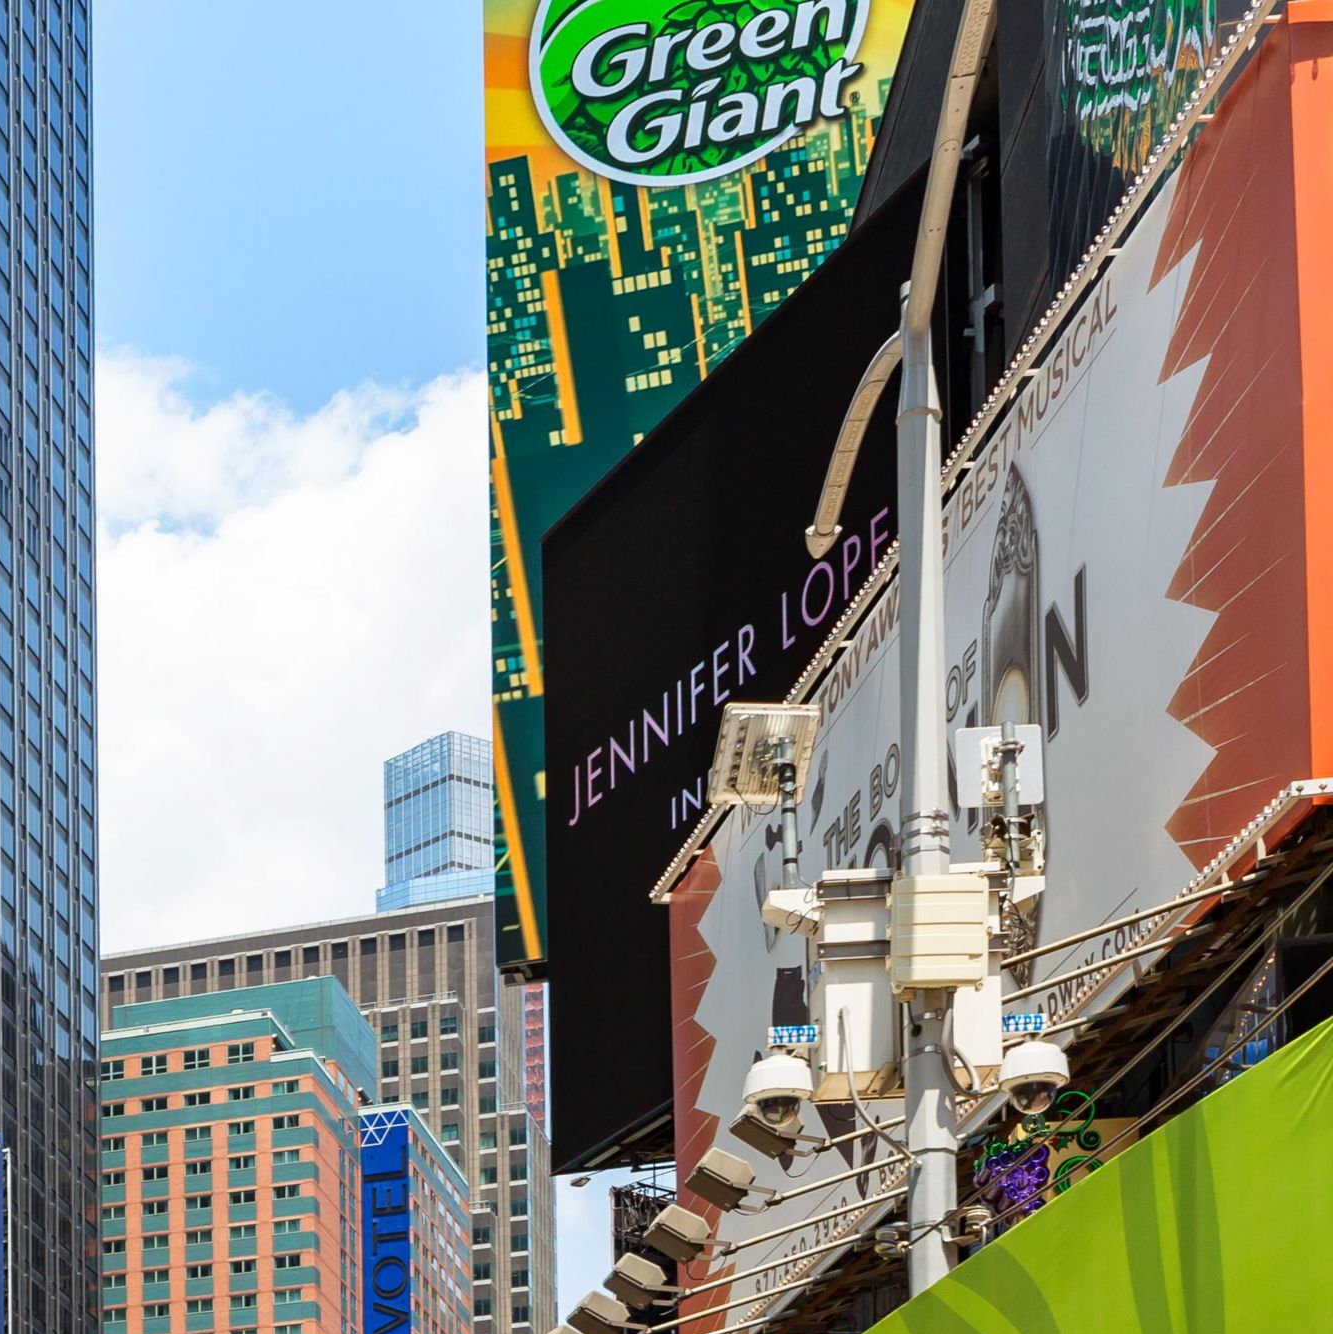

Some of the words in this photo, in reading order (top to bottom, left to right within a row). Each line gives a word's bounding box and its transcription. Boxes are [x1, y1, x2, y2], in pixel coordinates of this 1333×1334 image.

[572, 0, 848, 98] Green
[606, 59, 864, 164] Giant
[961, 423, 1011, 532] BEST
[1018, 287, 1118, 453] MUSICAL
[569, 623, 757, 826] JENNIFER
[782, 507, 889, 650] LOPE
[823, 790, 862, 870] THE
[870, 743, 900, 821] BO
[946, 639, 977, 722] OF
[773, 1026, 817, 1043] NYPD
[1002, 1013, 1044, 1032] NYPD
